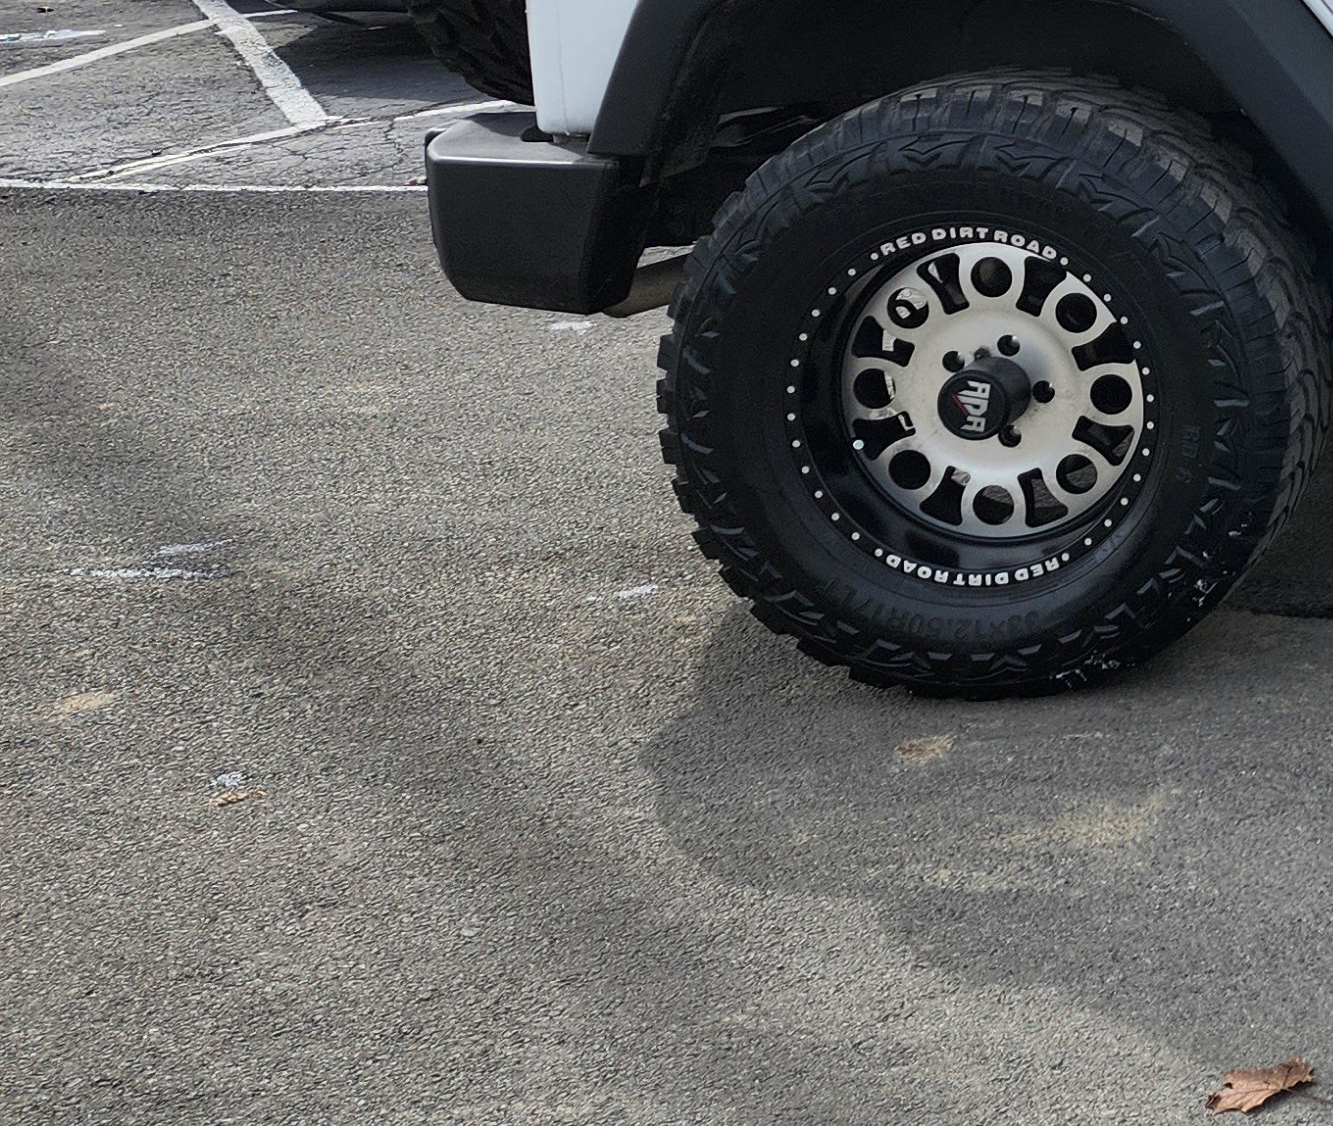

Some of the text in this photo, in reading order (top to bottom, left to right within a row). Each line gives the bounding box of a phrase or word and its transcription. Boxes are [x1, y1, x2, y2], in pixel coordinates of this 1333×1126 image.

[880, 226, 1057, 260] RED DIRT ROAD
[885, 554, 1060, 587] RED DIRT ROAD
